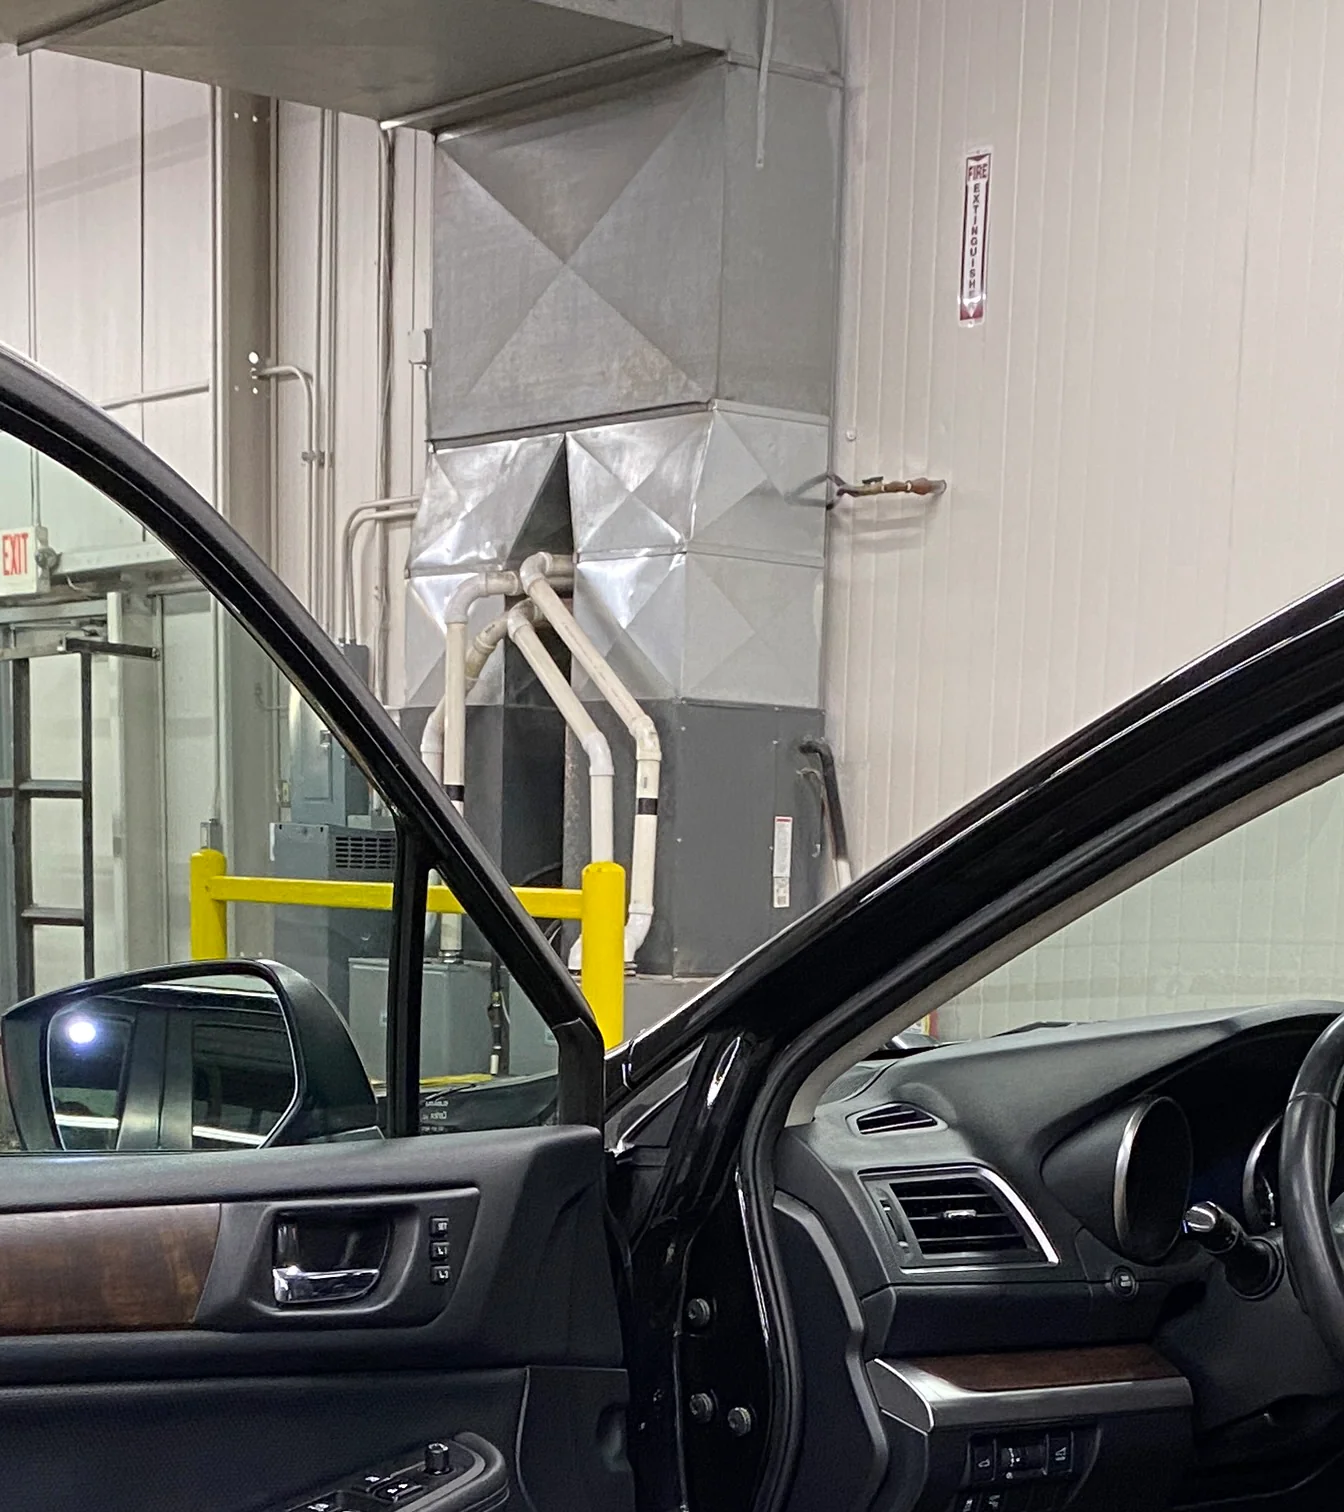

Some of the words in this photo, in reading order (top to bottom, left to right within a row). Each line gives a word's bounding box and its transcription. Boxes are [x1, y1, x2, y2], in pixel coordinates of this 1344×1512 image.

[968, 163, 988, 182] FIRE
[968, 183, 981, 309] EXTINGUISH
[2, 532, 28, 576] EXIT
